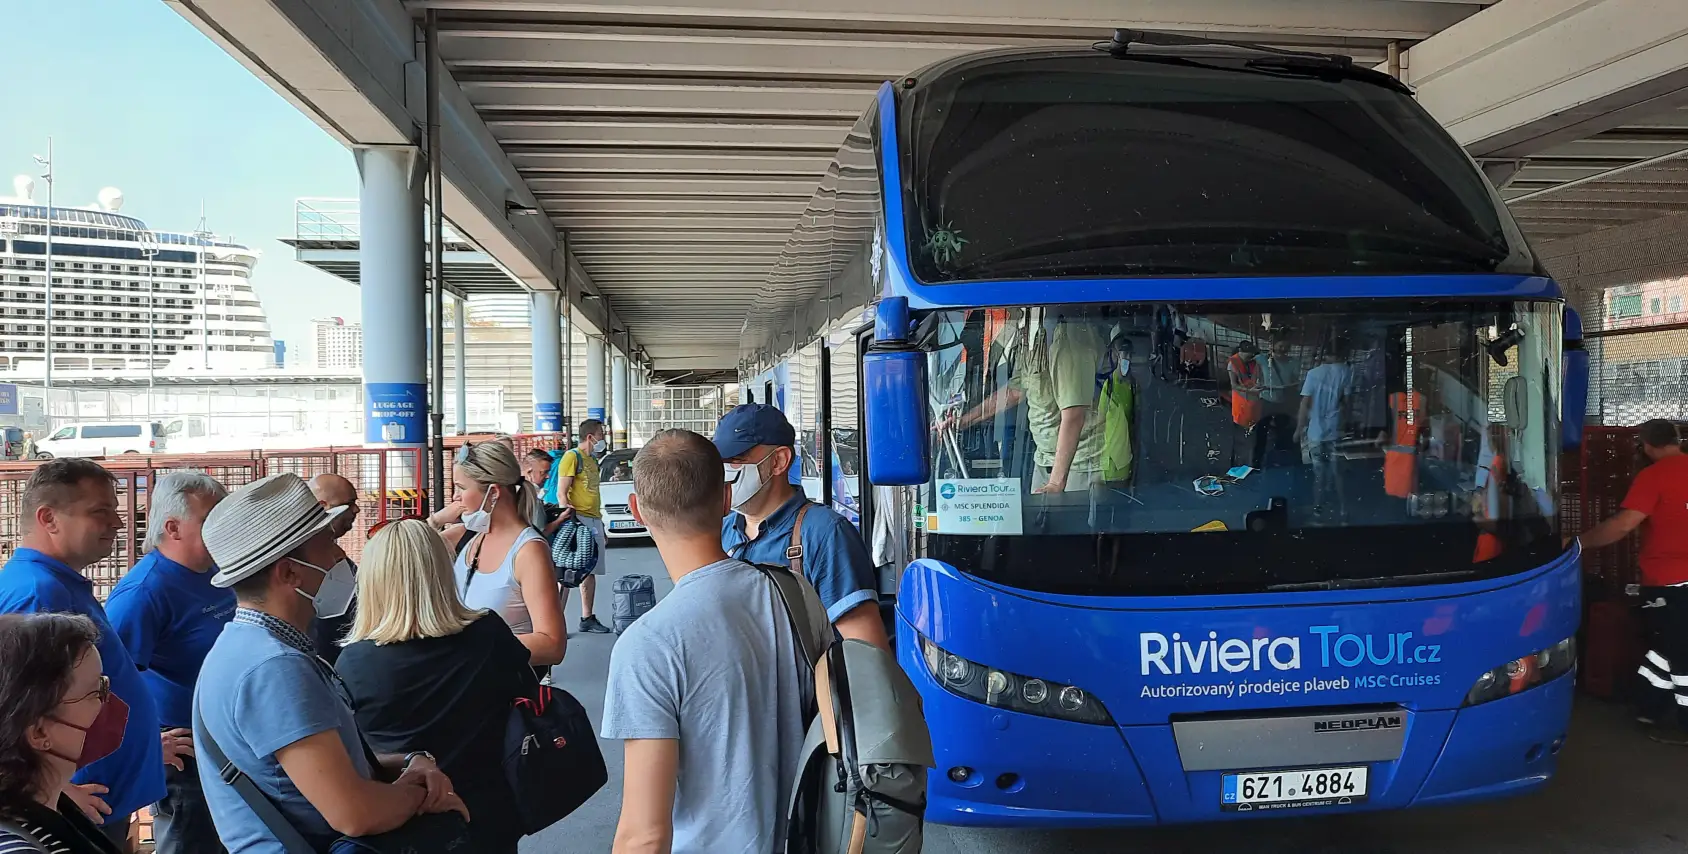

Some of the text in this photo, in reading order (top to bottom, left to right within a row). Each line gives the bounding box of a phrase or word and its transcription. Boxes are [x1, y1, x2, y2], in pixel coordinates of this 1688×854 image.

[958, 484, 988, 492] Riviera
[1140, 625, 1442, 676] Riviera Tour.cz
[1140, 672, 1442, 698] Autorizovaný prodejce plaveb MSC Cruises
[1314, 716, 1401, 732] NEOPLAN
[1224, 792, 1236, 800] CZ
[1242, 771, 1355, 800] 6Z1 4884
